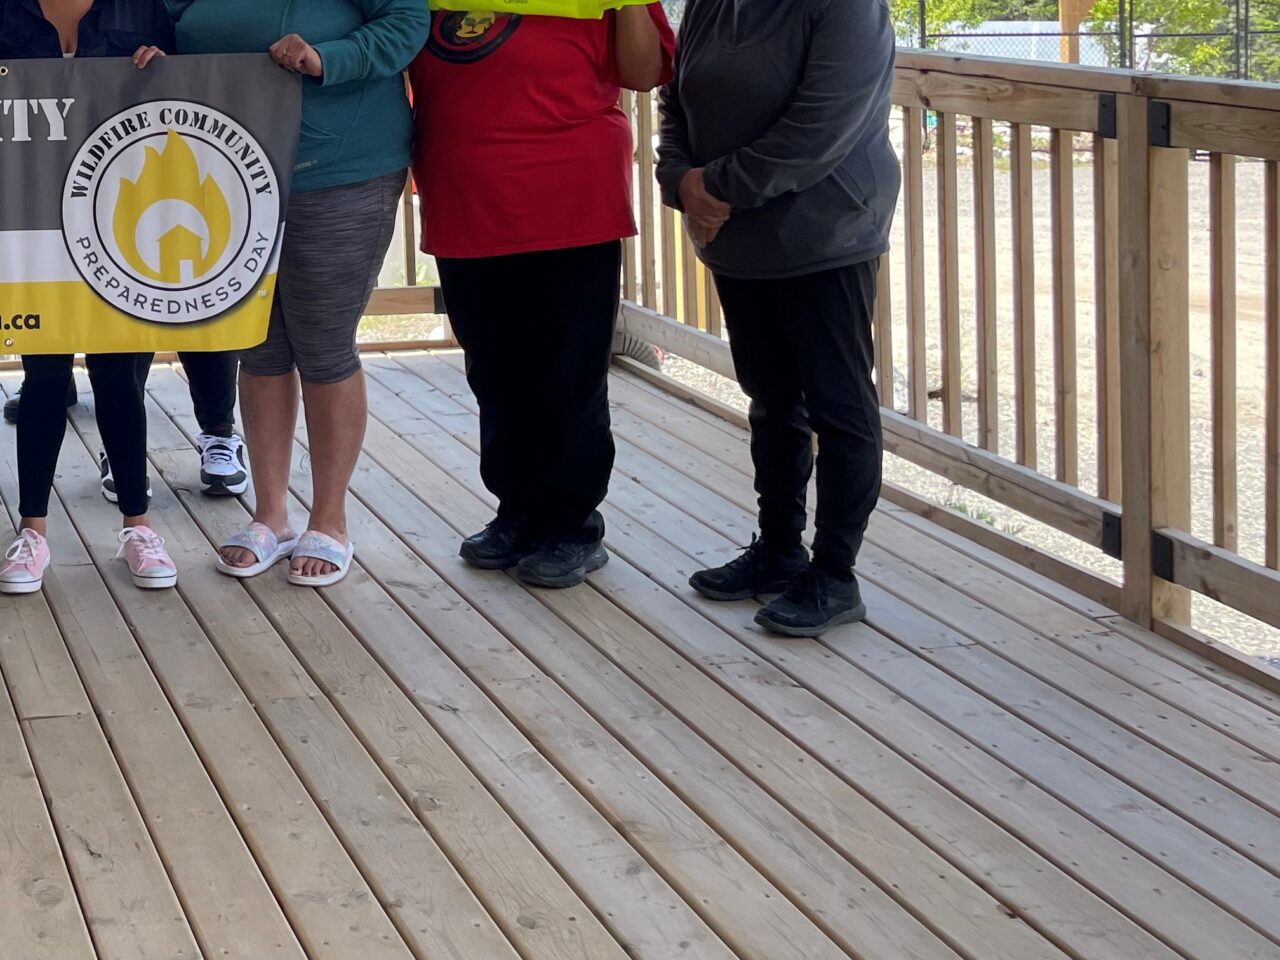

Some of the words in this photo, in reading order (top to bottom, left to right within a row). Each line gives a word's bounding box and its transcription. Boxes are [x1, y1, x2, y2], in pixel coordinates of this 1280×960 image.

[70, 111, 151, 199] WILDFIRE
[158, 108, 272, 195] COMMUNITY
[76, 236, 242, 315] PREPAREDNESS
[243, 231, 269, 273] DAY
